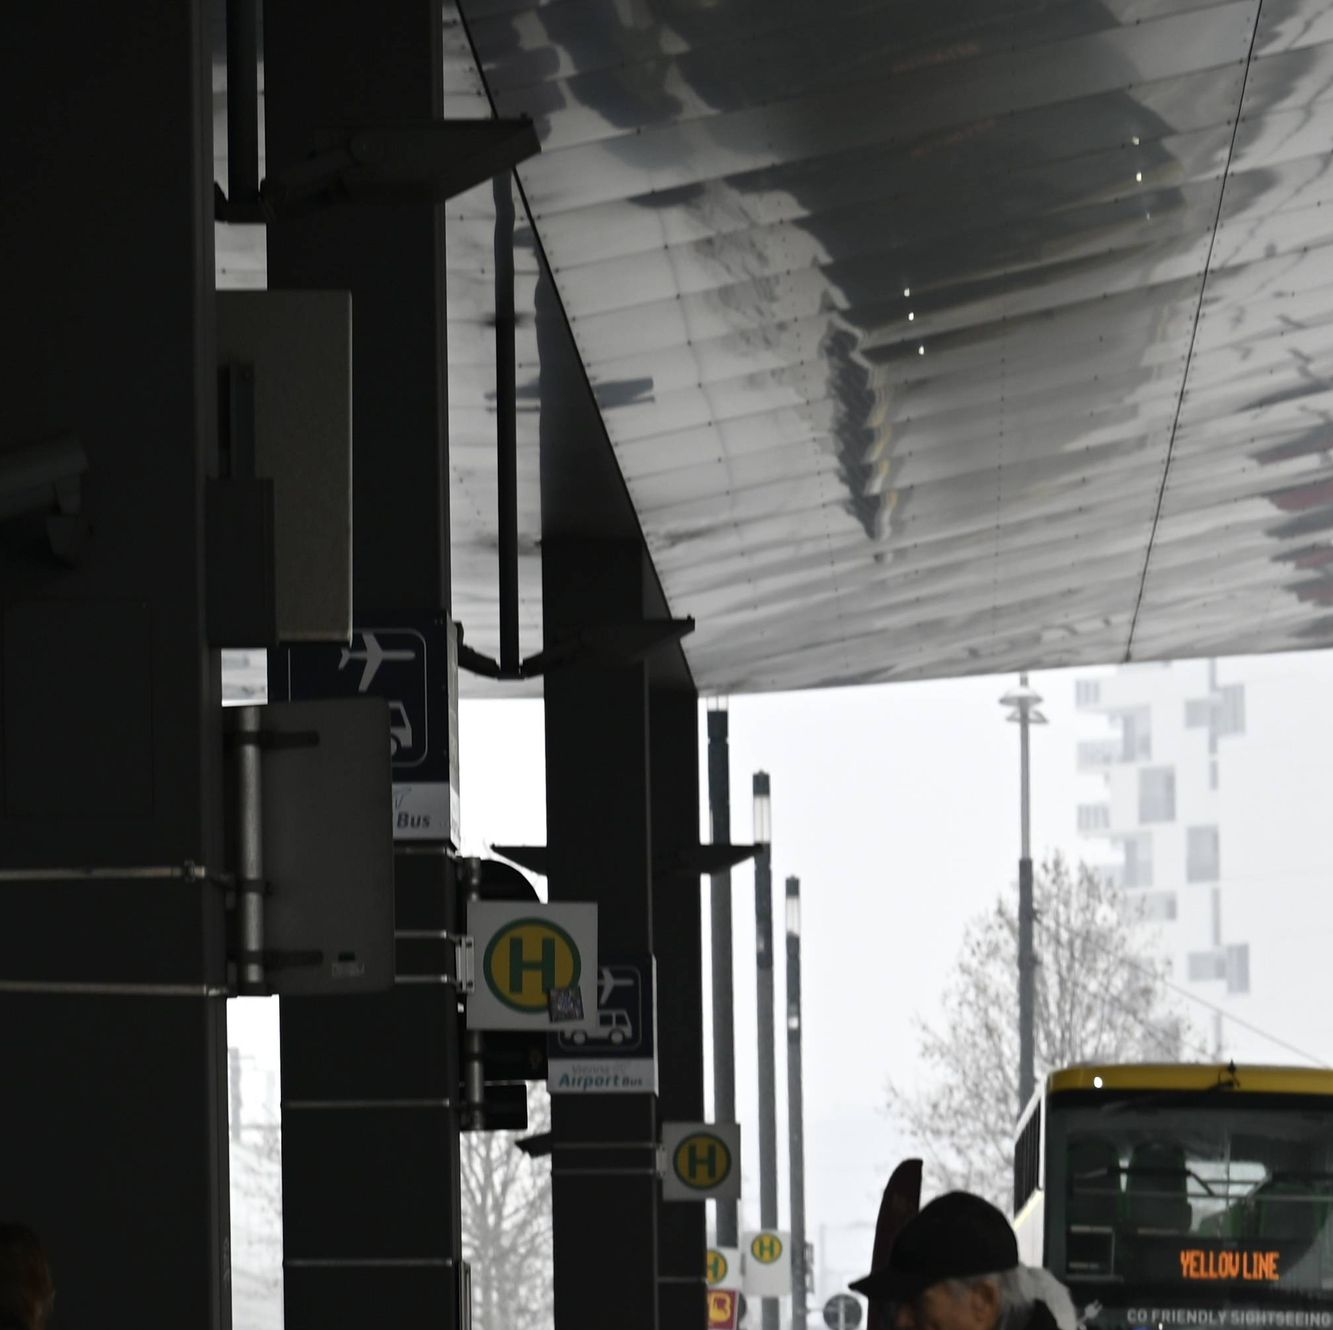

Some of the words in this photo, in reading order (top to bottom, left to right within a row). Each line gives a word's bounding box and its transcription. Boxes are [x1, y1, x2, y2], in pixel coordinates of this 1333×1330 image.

[396, 811, 431, 829] Bus
[509, 937, 555, 994] H
[559, 1072, 620, 1091] Airport
[688, 1144, 716, 1179] H
[1180, 1249, 1240, 1280] YELLOW
[1242, 1251, 1280, 1280] LINE
[1151, 1309, 1227, 1325] FRIENDLY
[1230, 1311, 1331, 1328] SIGHTSEEING
